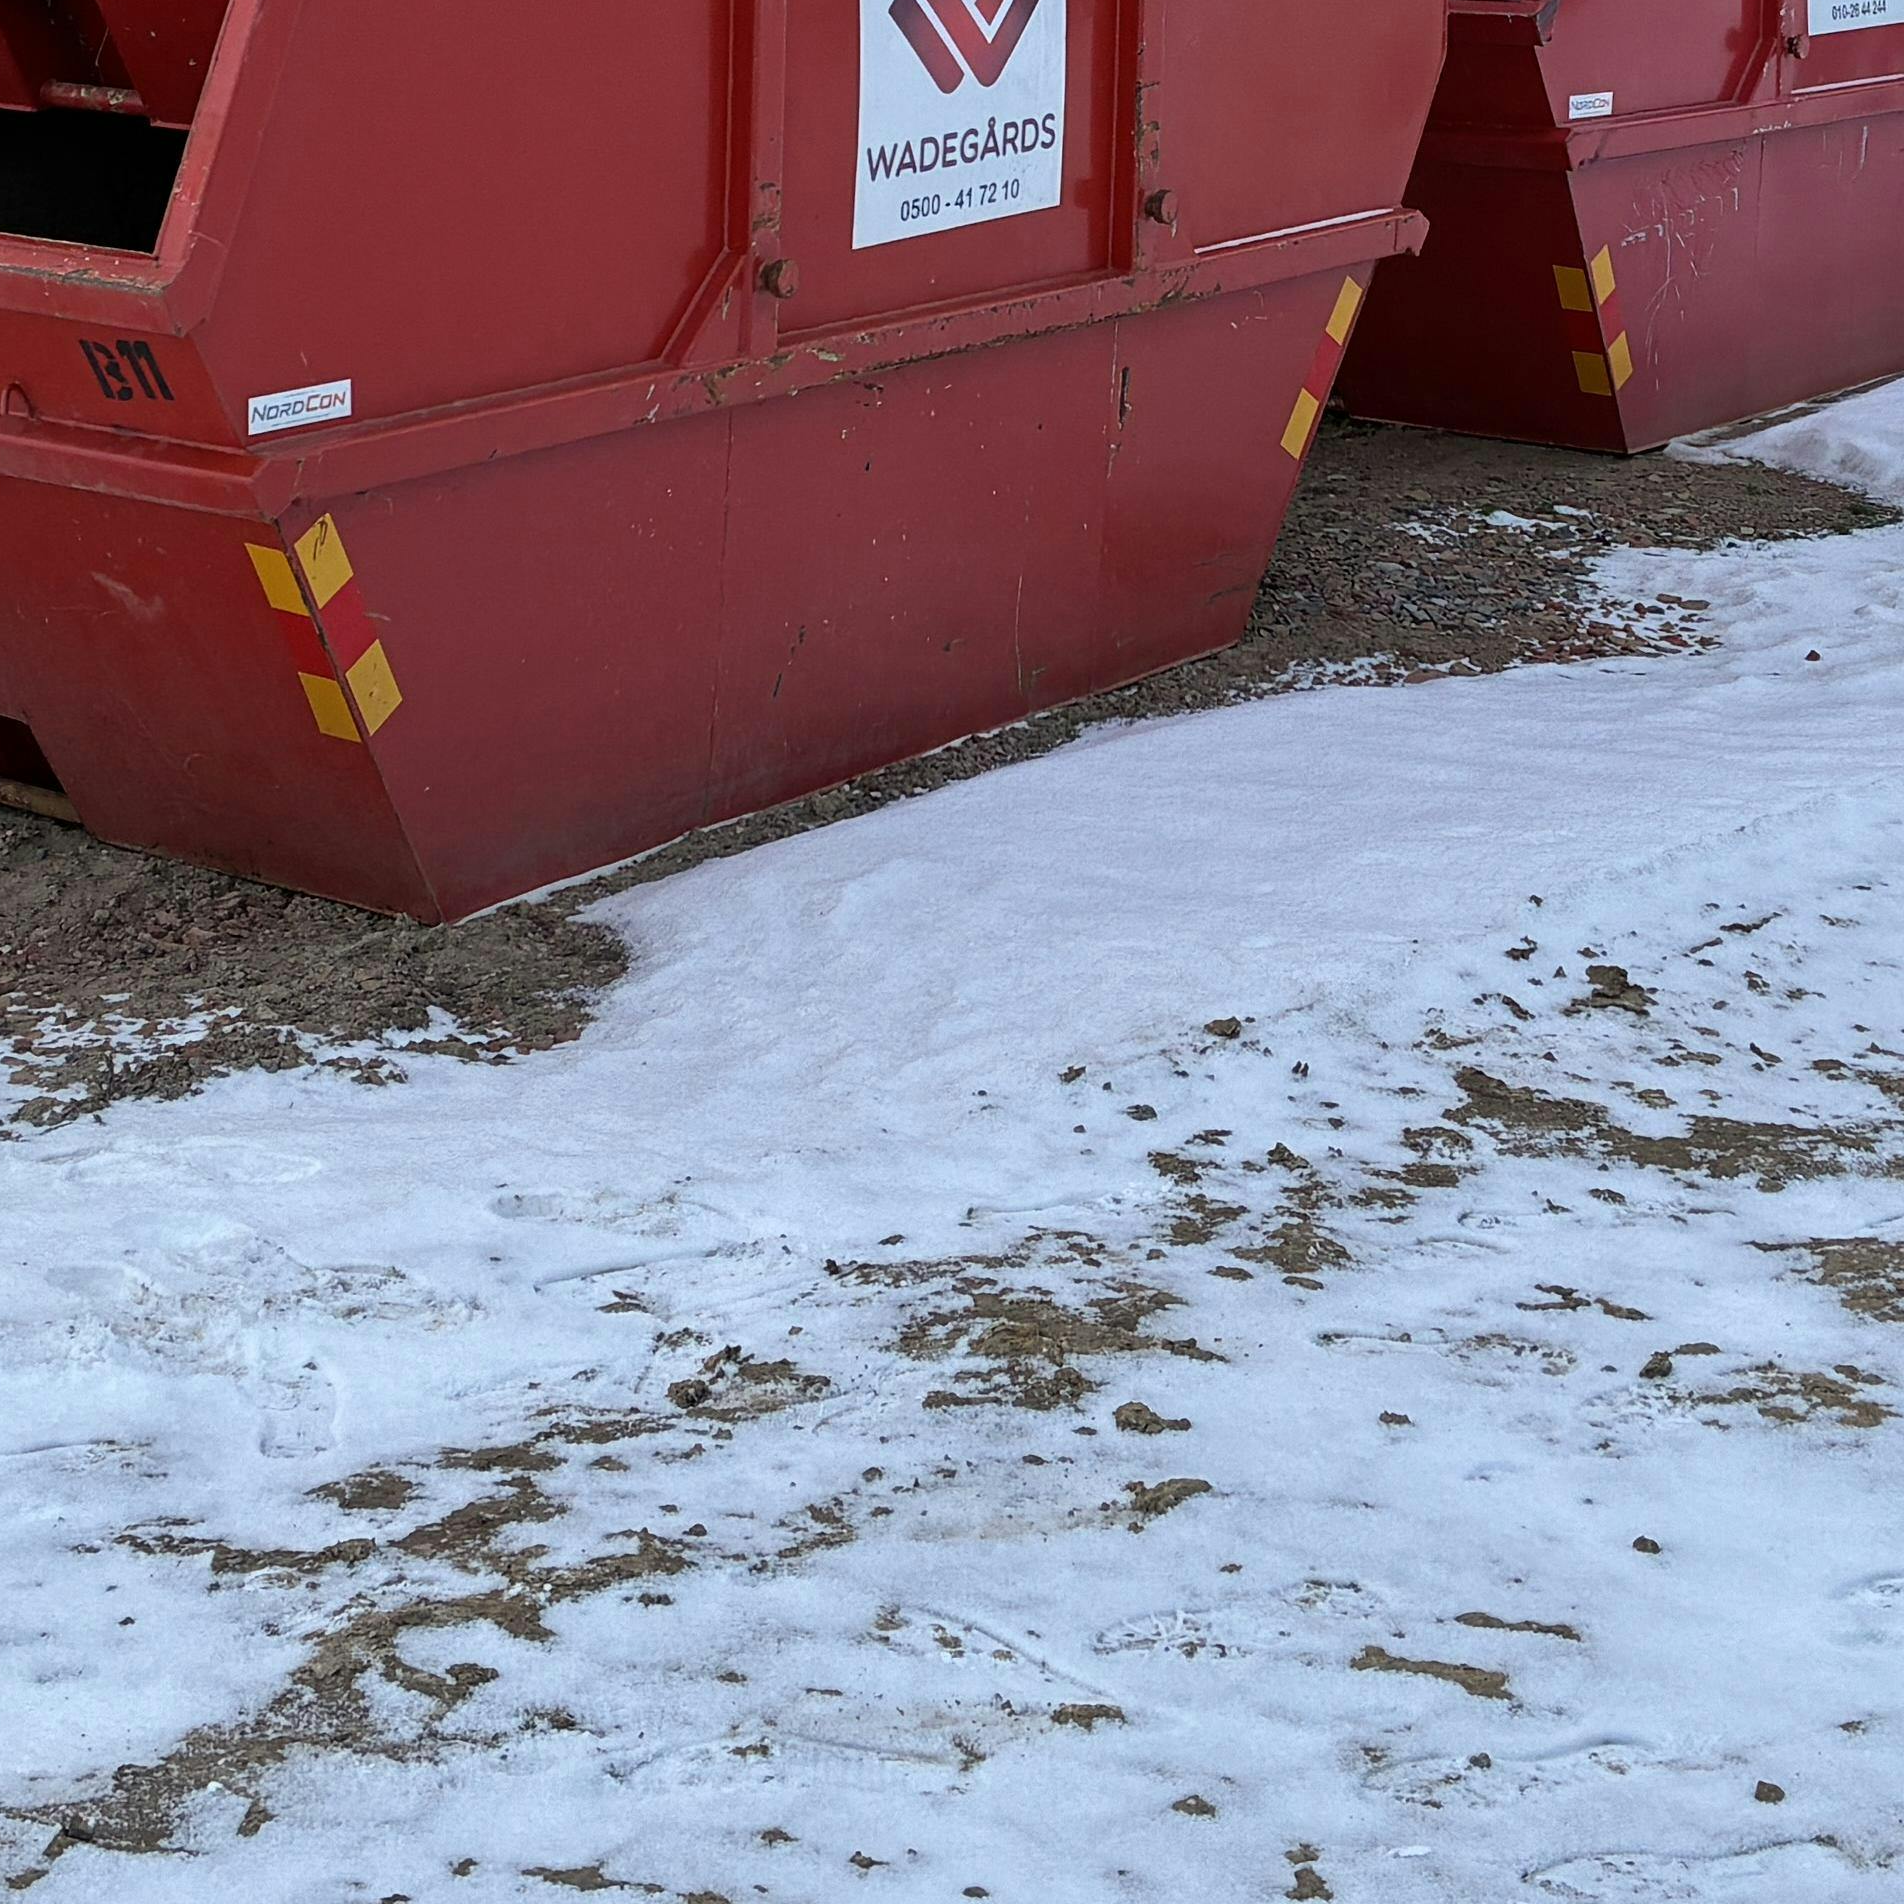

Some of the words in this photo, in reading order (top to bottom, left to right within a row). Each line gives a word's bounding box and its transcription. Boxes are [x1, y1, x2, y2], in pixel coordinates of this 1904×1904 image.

[867, 113, 1056, 182] WADEGÅRDS
[900, 194, 941, 222] 0500
[954, 187, 973, 209] 41
[979, 182, 997, 206] 72
[1001, 178, 1020, 199] 10
[79, 339, 175, 402] B11
